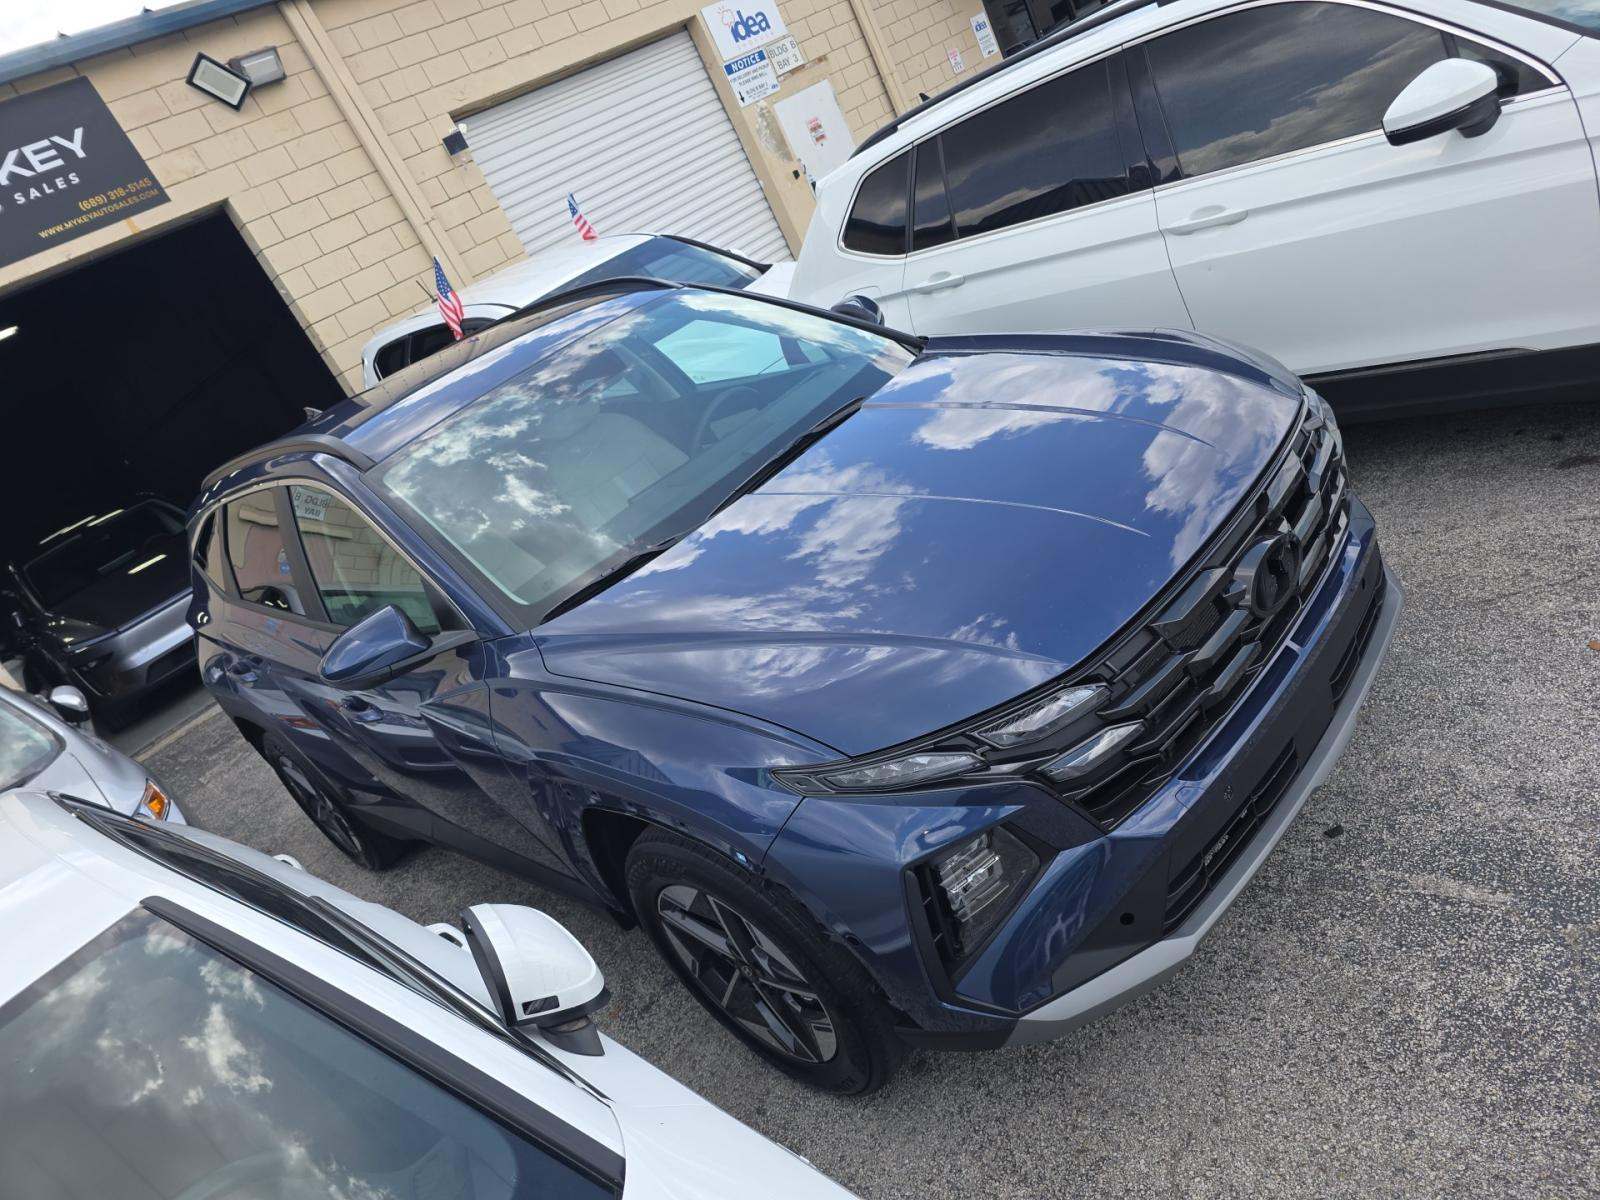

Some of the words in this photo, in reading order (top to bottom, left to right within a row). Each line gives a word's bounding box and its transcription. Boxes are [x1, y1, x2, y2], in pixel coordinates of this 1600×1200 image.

[730, 9, 772, 43] idea
[730, 53, 760, 72] NOTICE
[768, 43, 789, 59] BLDG
[789, 40, 797, 50] B
[776, 58, 792, 70] BAY
[793, 53, 800, 63] 3
[14, 172, 80, 204] SALES
[78, 193, 107, 211] (689)
[108, 178, 151, 200] 318-5145
[38, 189, 159, 239] WWW.MYKEYAUTOSALES.COM
